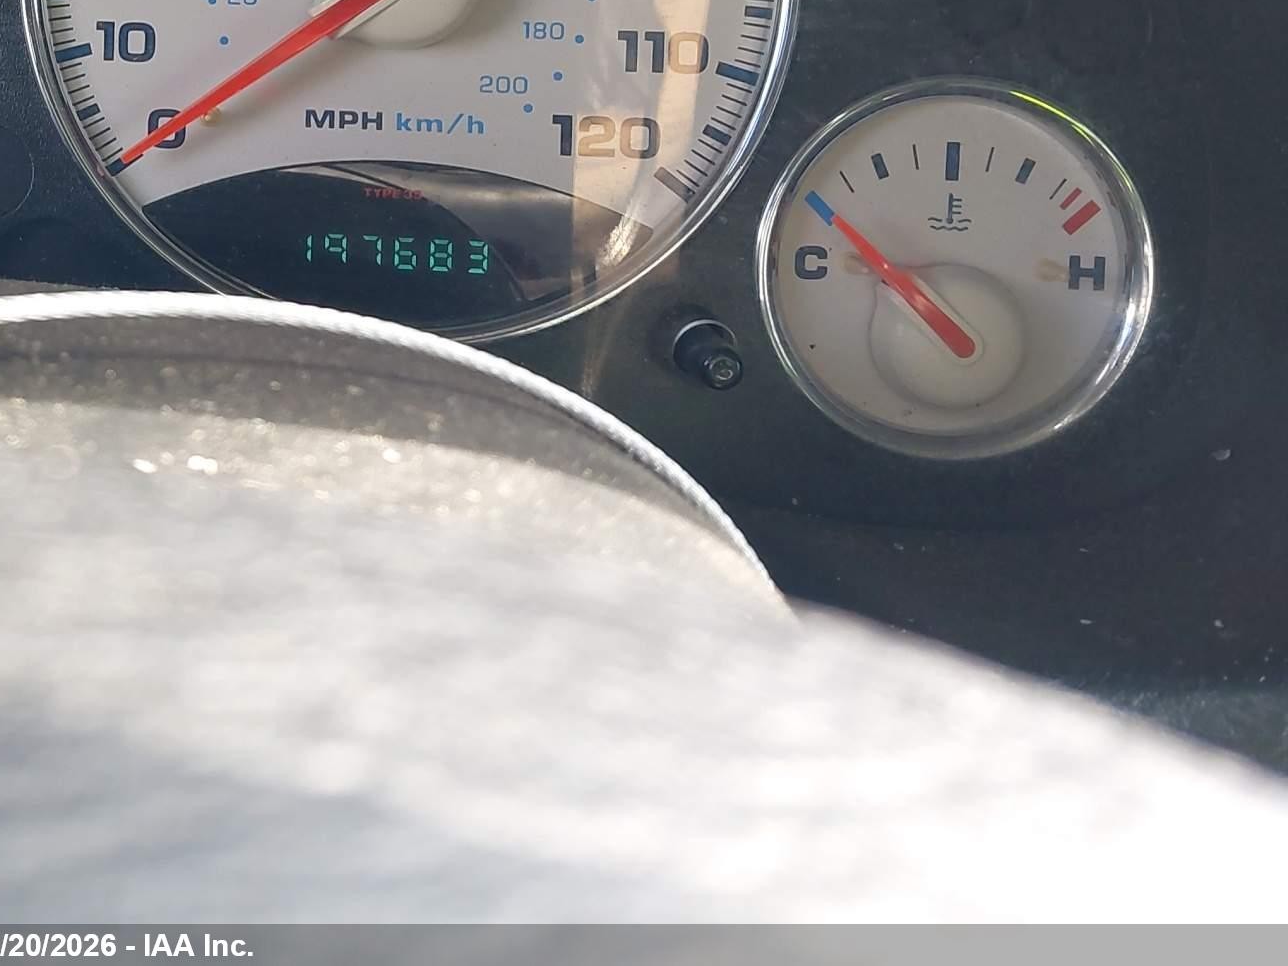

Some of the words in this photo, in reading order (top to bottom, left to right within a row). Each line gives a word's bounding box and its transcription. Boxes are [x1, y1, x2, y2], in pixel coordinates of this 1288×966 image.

[95, 20, 157, 63] 10
[523, 22, 565, 41] 180
[617, 29, 710, 74] 110
[479, 76, 530, 96] 200
[304, 108, 384, 132] MPH
[395, 112, 486, 136] km/h
[550, 113, 662, 160] 120
[306, 233, 489, 274] 197683
[794, 245, 829, 280] C
[1068, 255, 1106, 291] H
